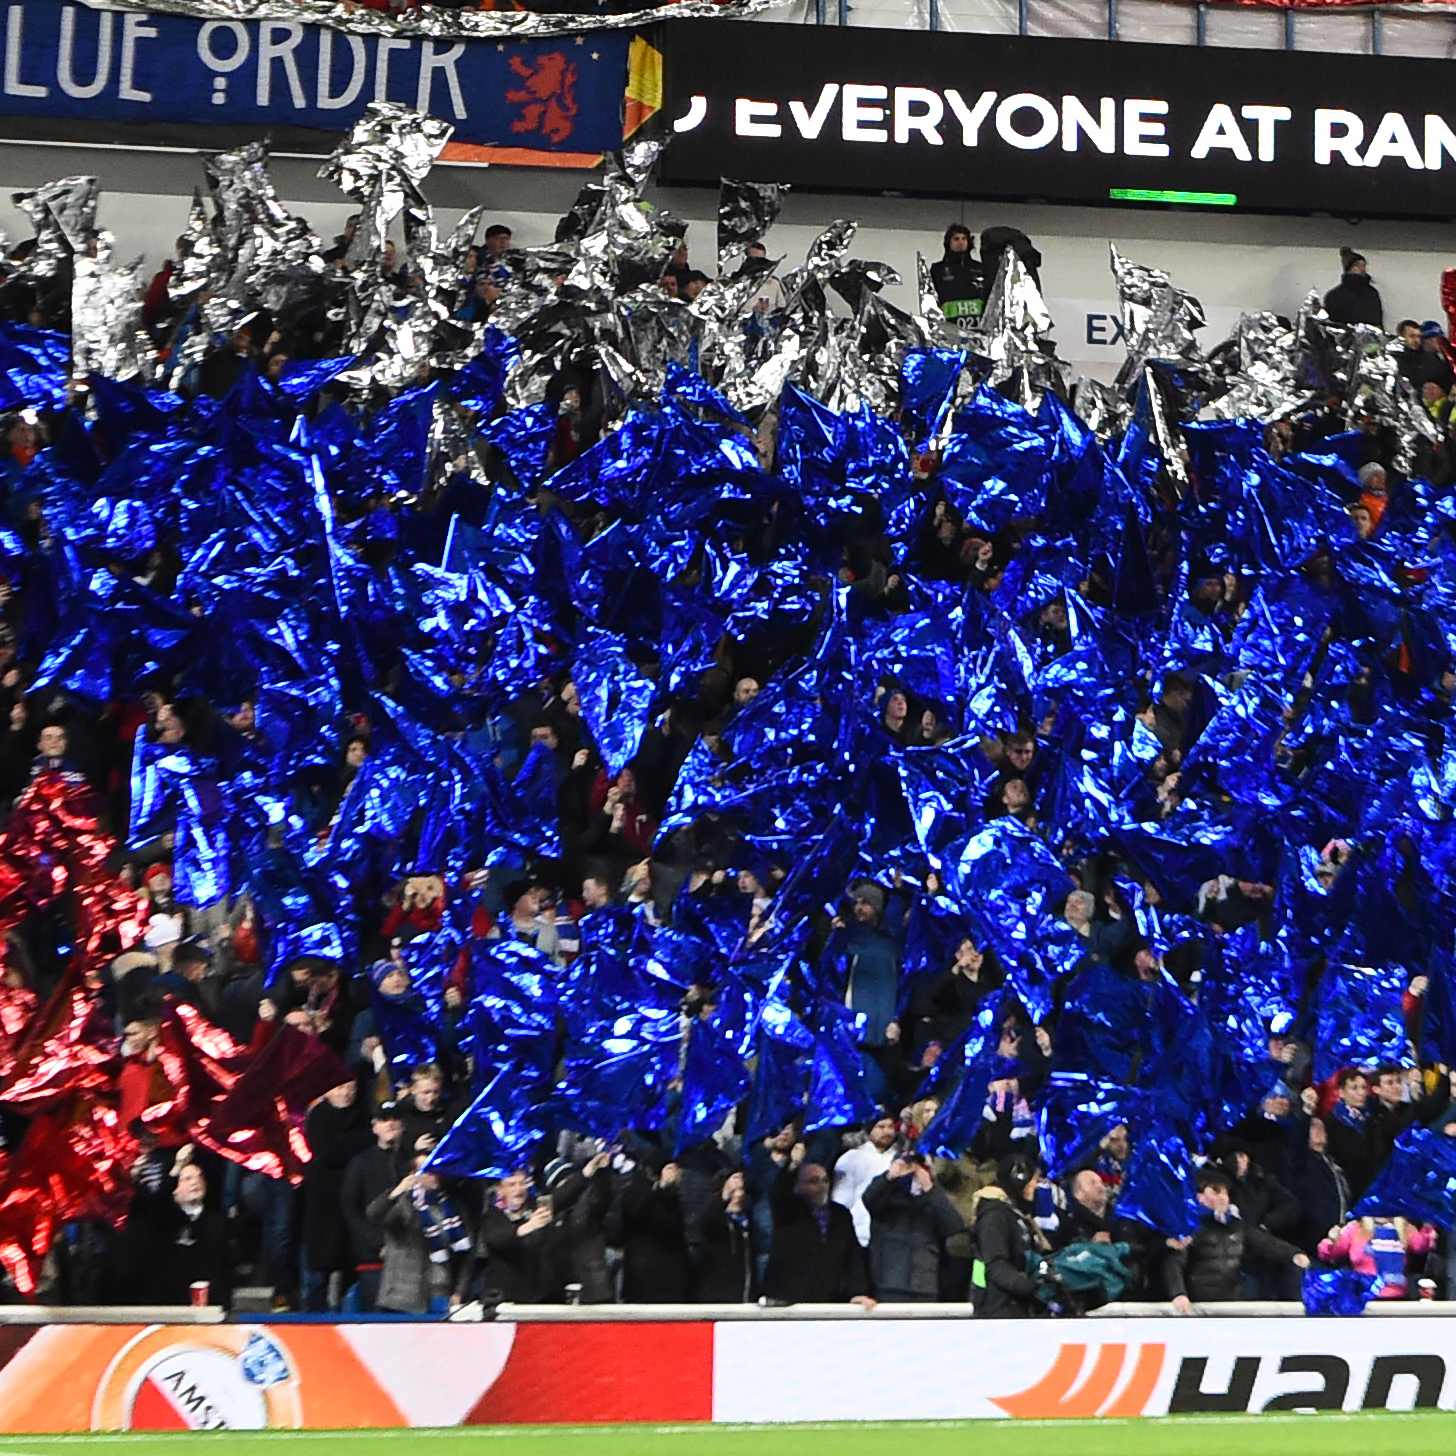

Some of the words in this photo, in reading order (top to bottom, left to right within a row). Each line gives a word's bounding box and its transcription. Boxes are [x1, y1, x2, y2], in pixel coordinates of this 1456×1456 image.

[196, 19, 468, 120] ORDER
[735, 82, 1170, 157] EVERYONE
[1190, 102, 1292, 162] AT
